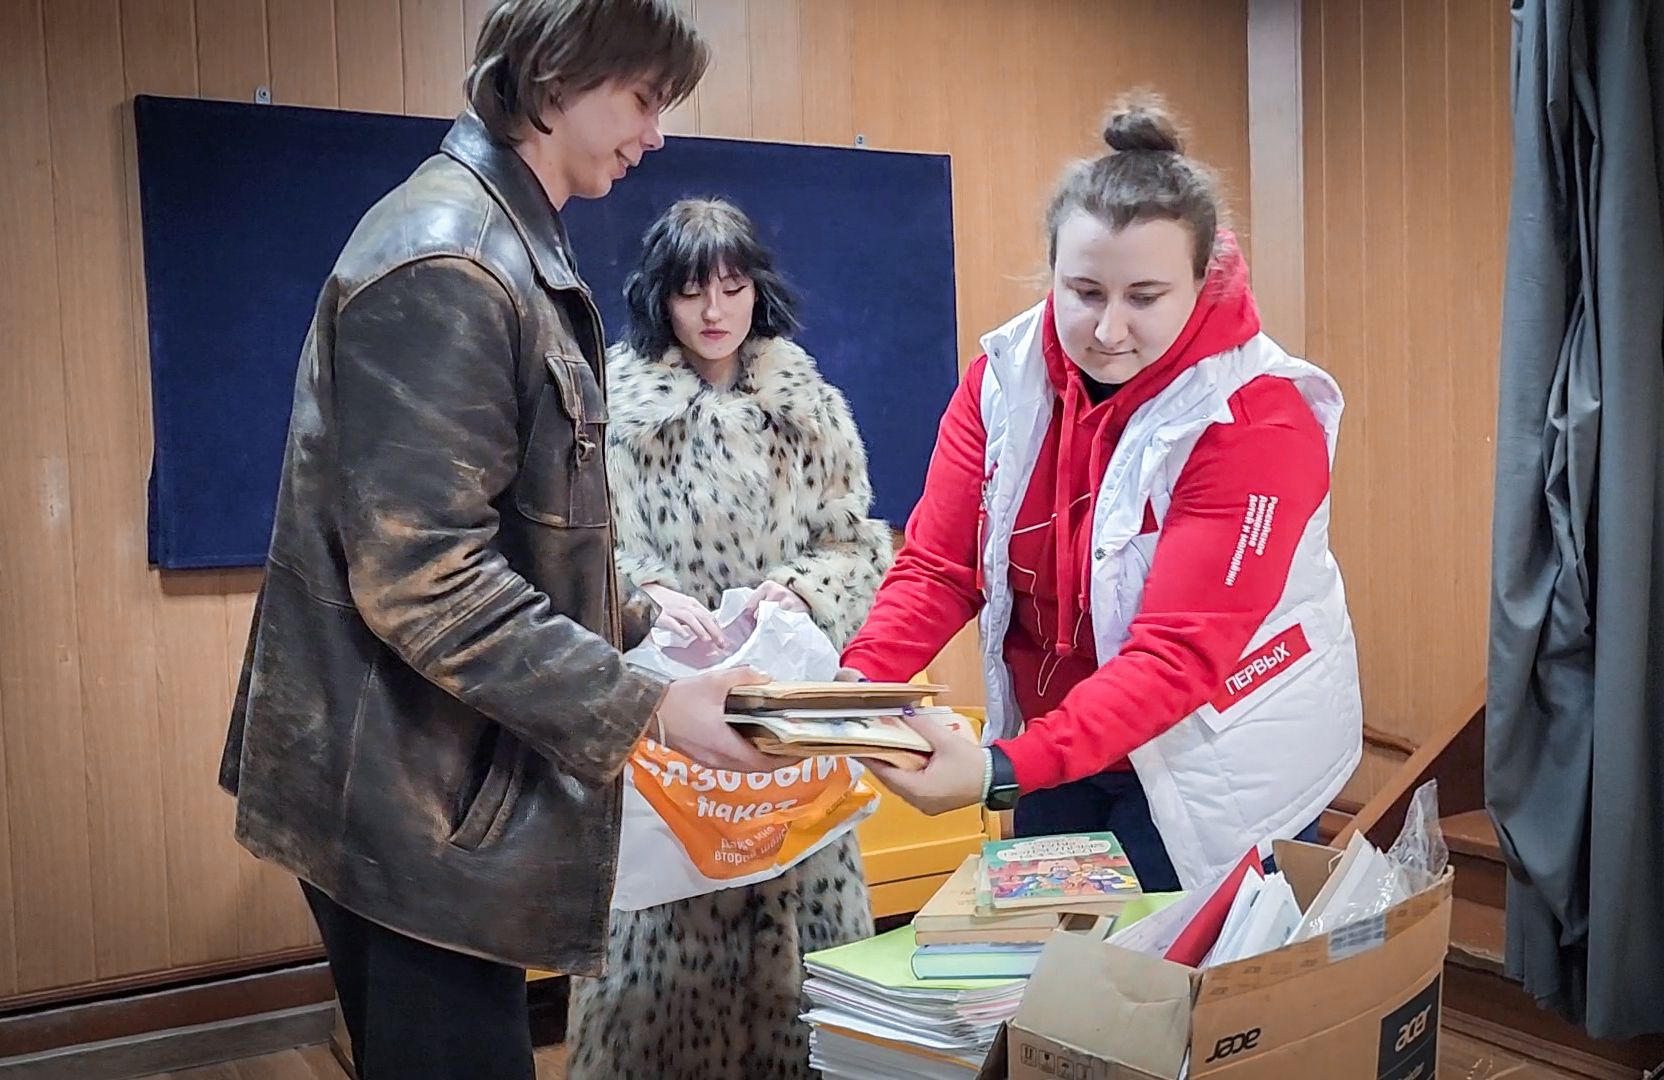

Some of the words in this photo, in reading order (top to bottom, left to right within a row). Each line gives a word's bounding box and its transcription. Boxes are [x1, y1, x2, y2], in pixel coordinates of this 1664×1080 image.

[1224, 642, 1291, 695] ПЕРВЫХ
[1204, 1027, 1262, 1063] acer
[1394, 1004, 1432, 1052] acer
